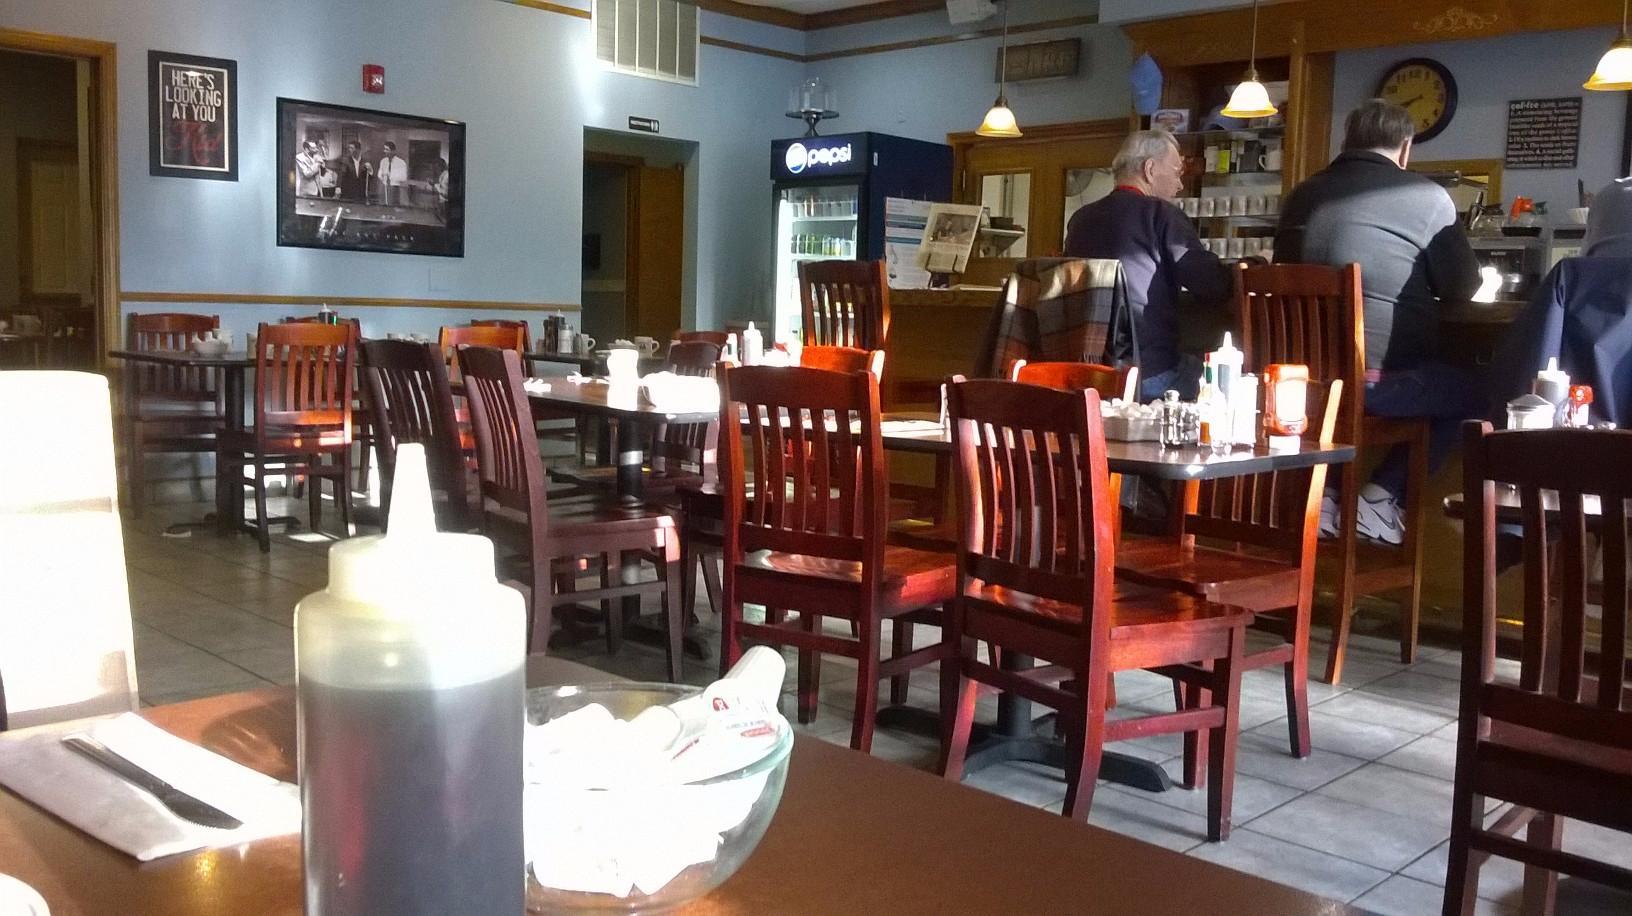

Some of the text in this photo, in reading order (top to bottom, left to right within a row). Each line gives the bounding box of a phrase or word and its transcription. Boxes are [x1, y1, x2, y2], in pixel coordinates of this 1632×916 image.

[172, 68, 215, 90] HERE'S
[165, 85, 222, 107] LOOKING
[172, 102, 216, 123] AT YOU
[807, 142, 852, 168] pepsi
